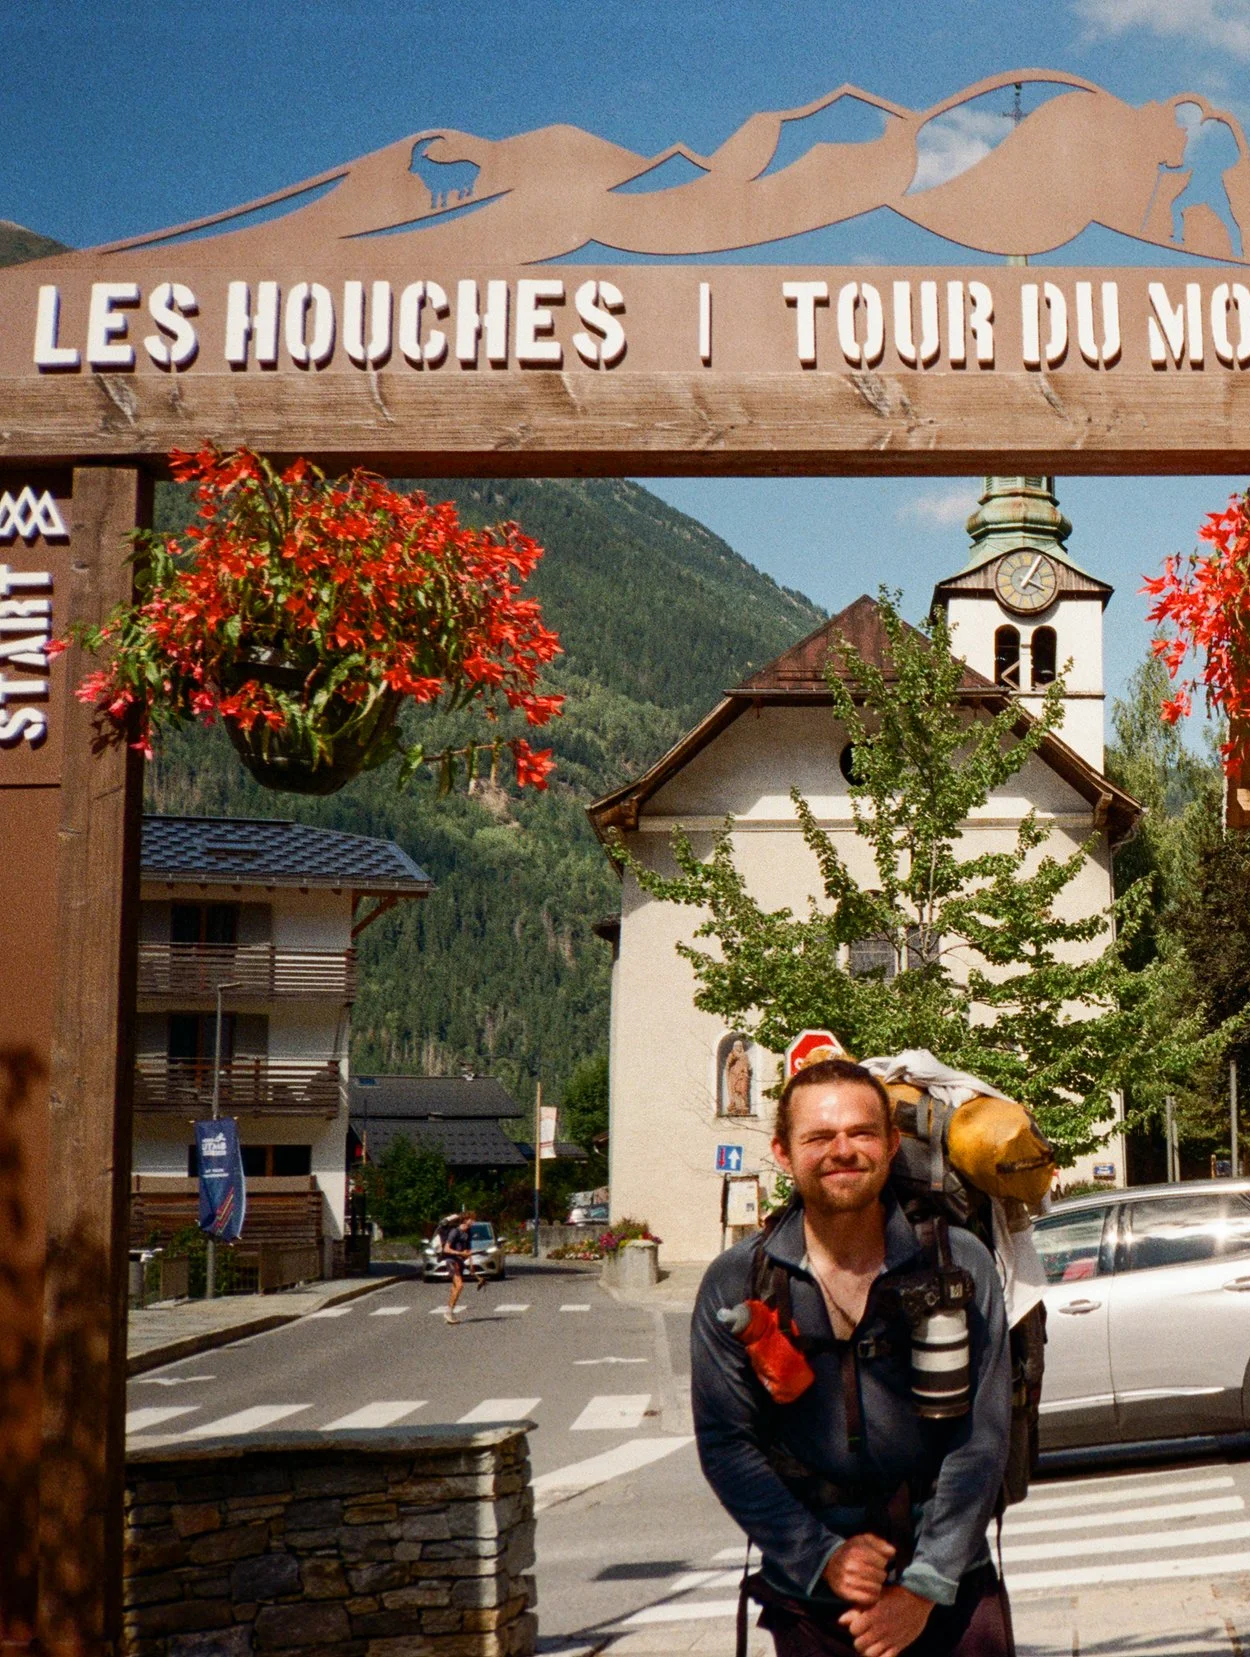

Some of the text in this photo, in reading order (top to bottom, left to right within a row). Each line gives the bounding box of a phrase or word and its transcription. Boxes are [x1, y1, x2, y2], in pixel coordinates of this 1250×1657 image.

[34, 283, 196, 364] LES
[226, 280, 626, 362] HOUCHES
[782, 281, 994, 362] TOUR
[1021, 281, 1121, 362] DU
[0, 564, 51, 741] START
